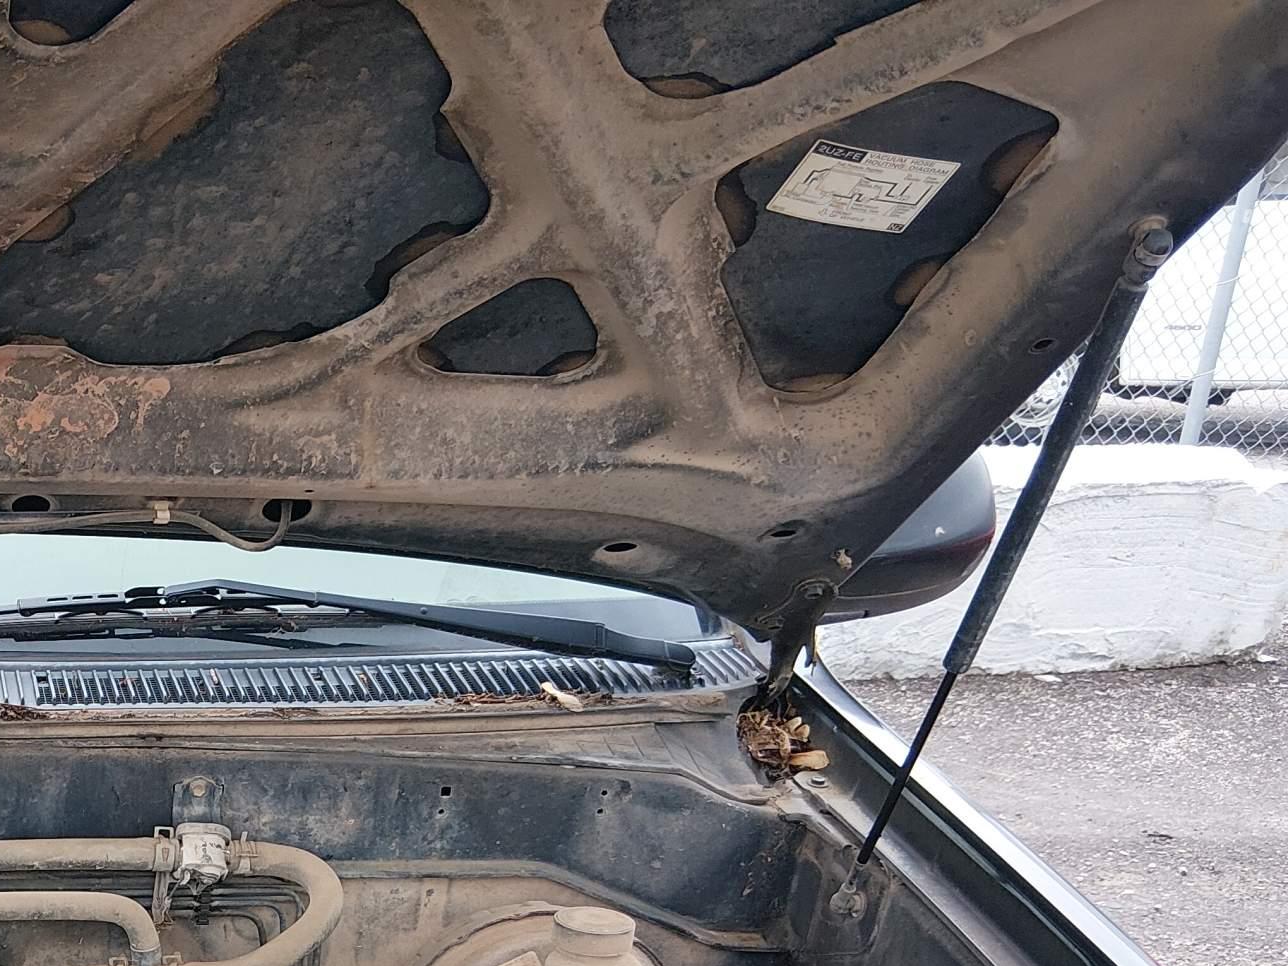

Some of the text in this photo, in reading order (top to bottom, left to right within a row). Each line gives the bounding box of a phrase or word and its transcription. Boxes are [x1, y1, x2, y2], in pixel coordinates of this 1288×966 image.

[817, 144, 864, 161] 2UZ-FE
[869, 153, 935, 167] VACUUM HOSE
[864, 158, 906, 171] ROUTING
[908, 165, 949, 176] DIAGRAM
